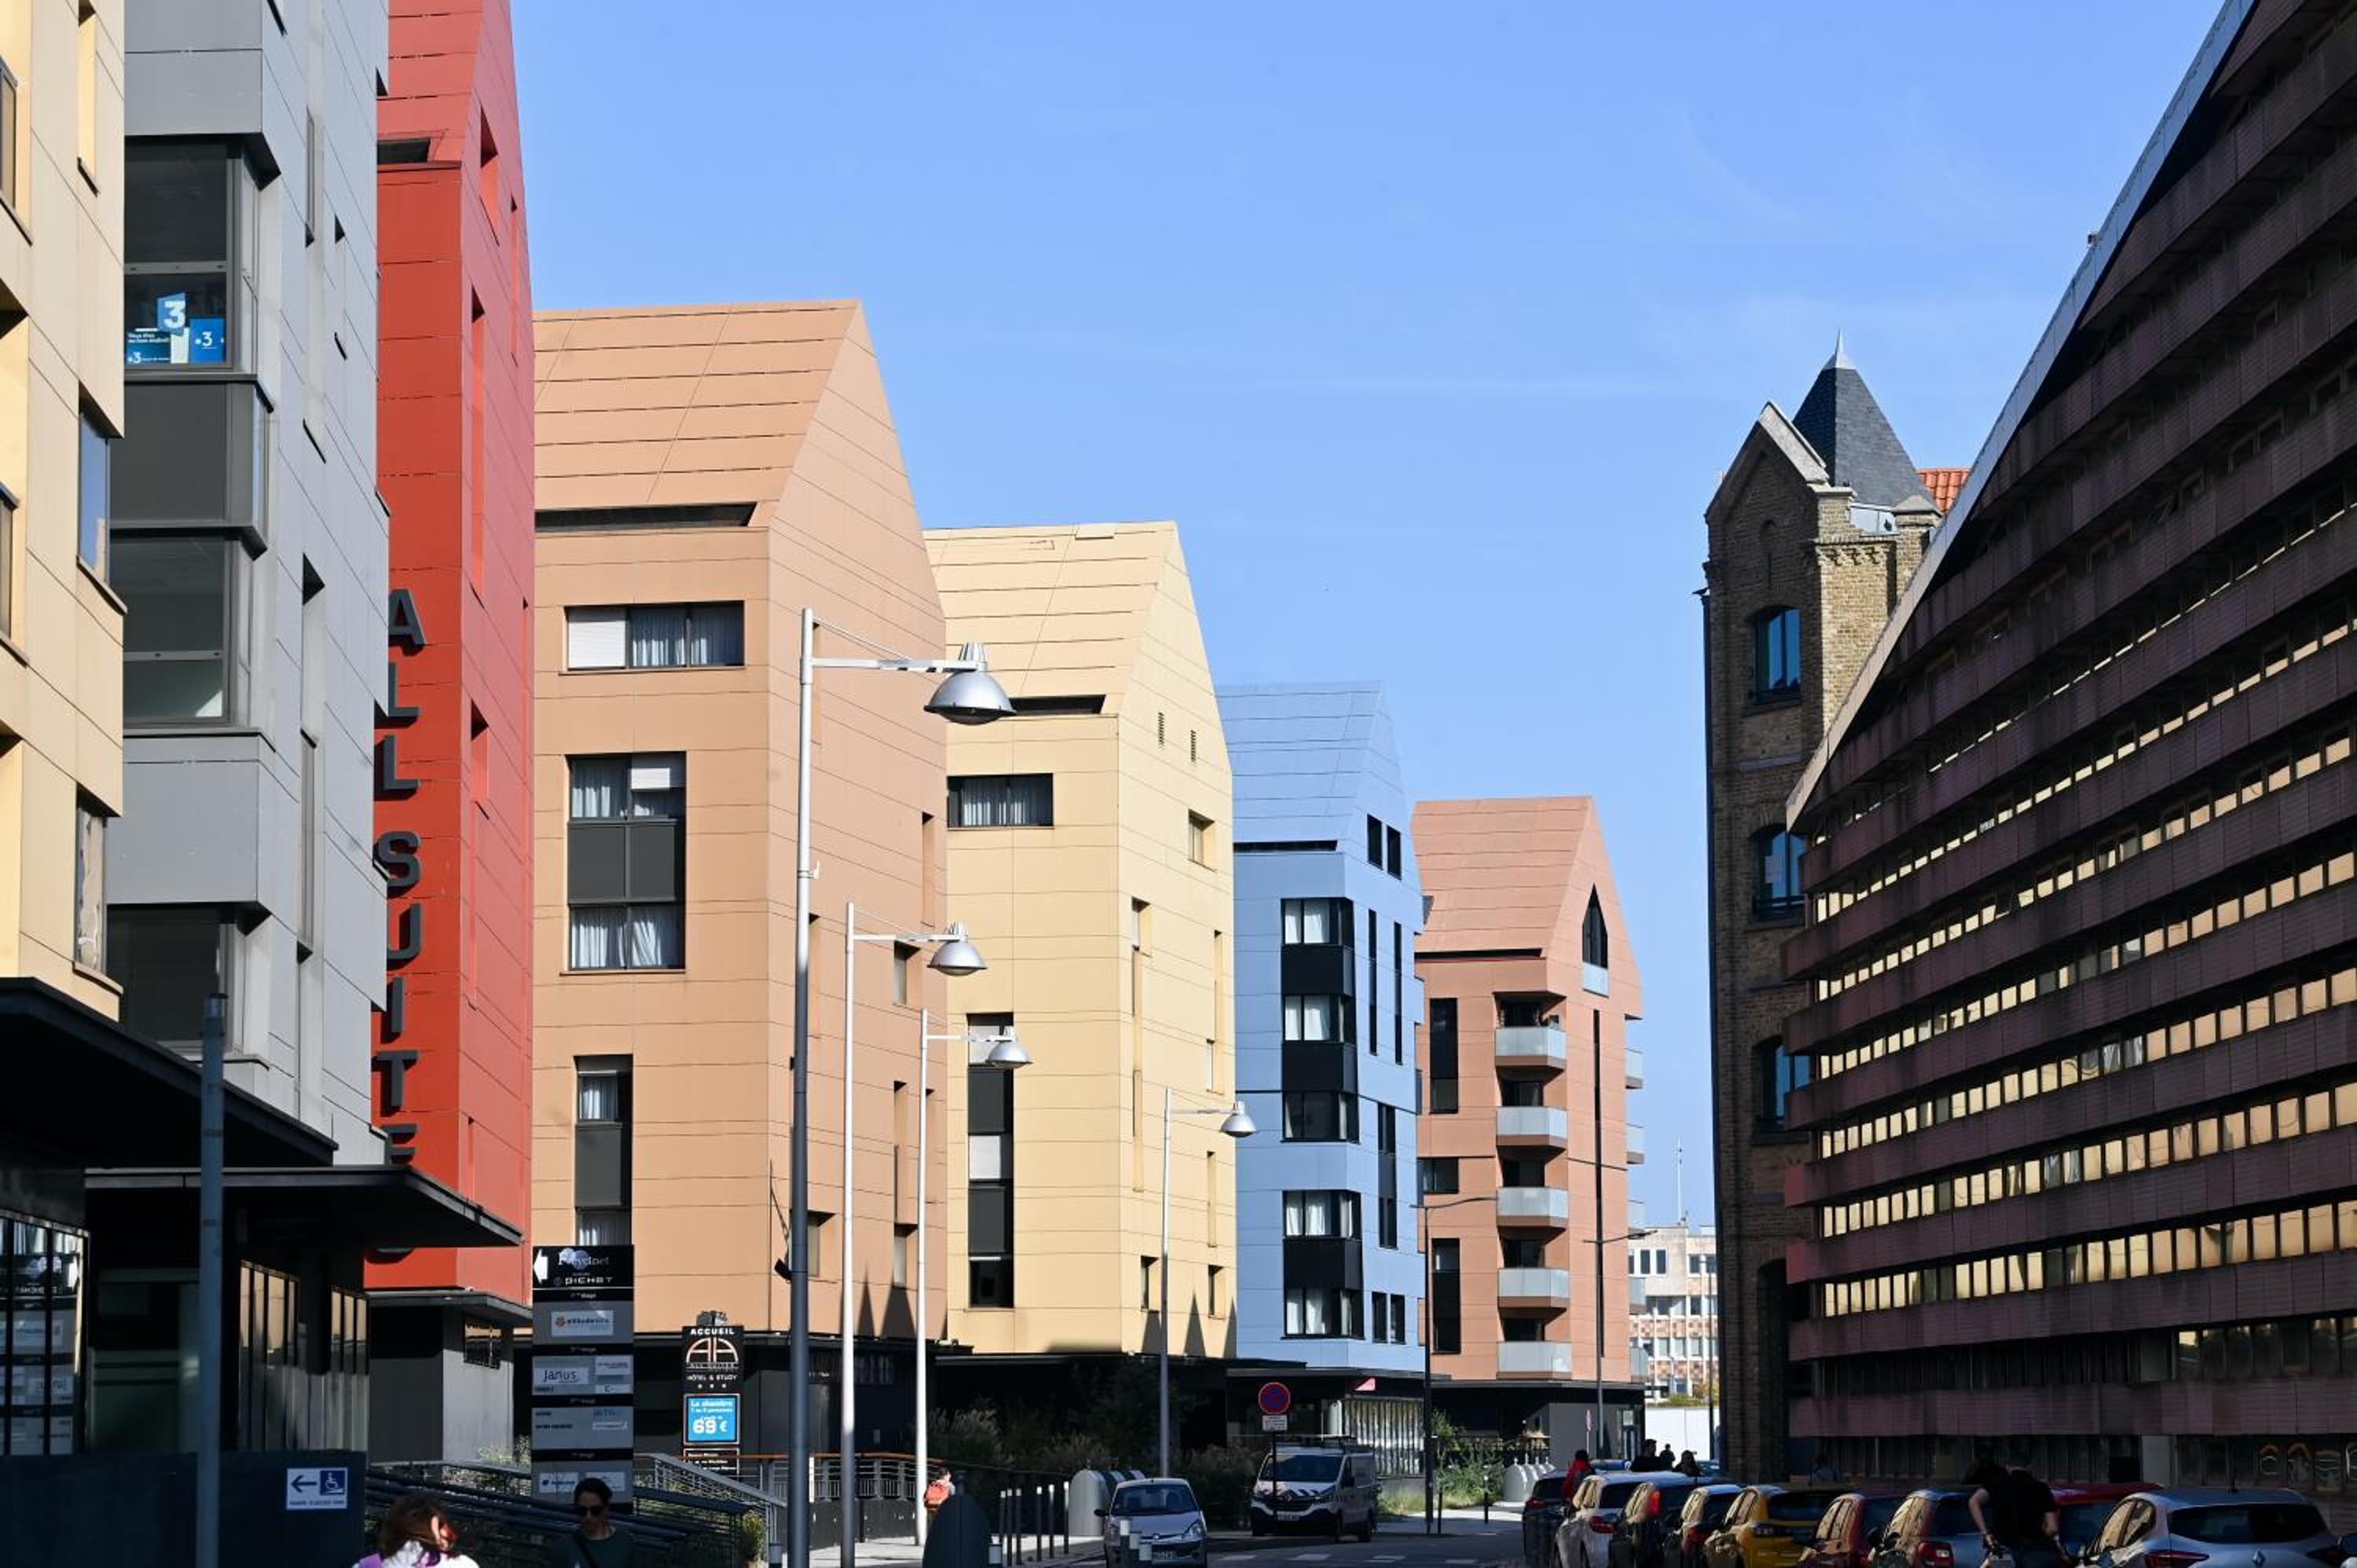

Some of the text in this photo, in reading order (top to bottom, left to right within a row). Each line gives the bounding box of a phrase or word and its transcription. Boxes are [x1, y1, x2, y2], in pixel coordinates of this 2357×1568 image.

[164, 301, 186, 328] 3
[202, 331, 213, 346] 3
[377, 588, 427, 1253] ALL SUITE
[543, 1369, 577, 1383] Janus
[693, 1419, 728, 1434] 69 €
